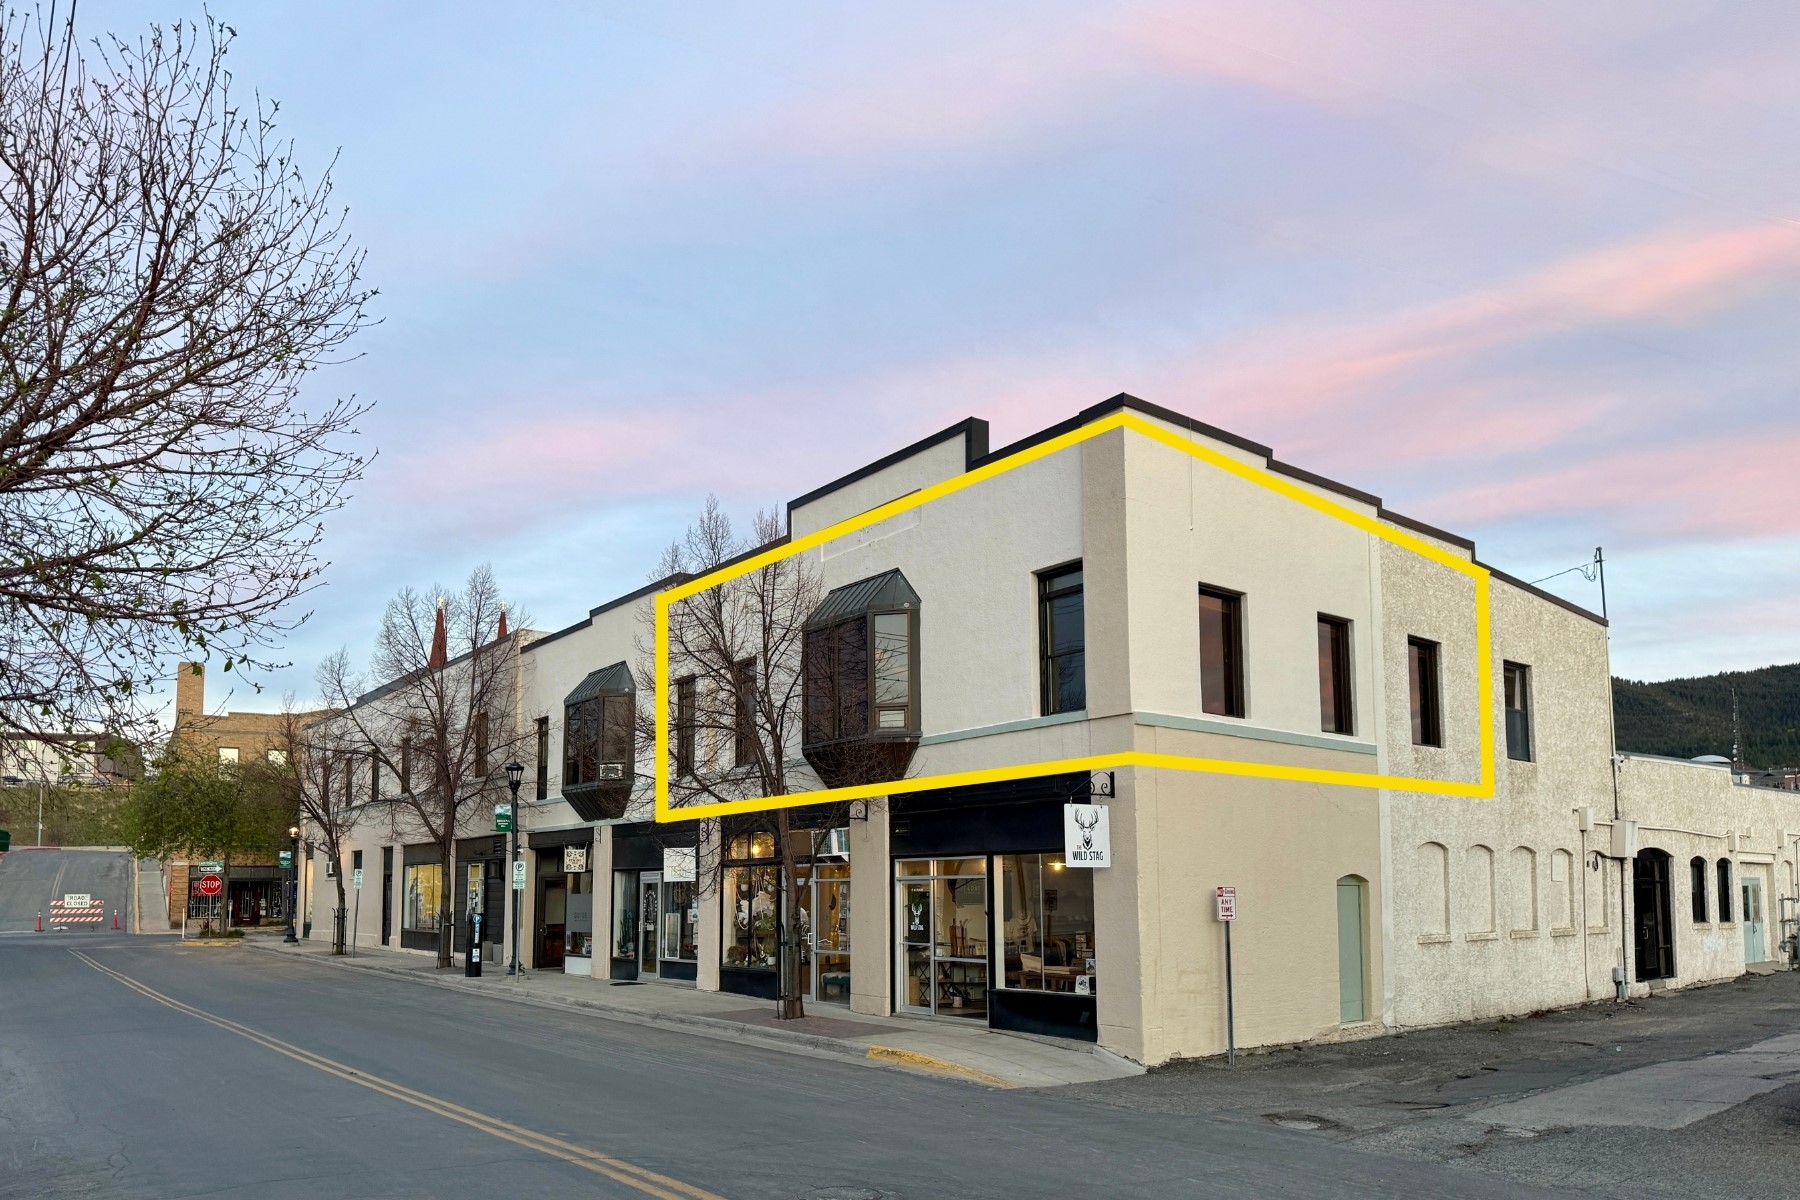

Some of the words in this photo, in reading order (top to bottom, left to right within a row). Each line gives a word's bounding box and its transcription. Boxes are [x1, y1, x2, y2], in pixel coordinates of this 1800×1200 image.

[1072, 851, 1088, 860] WILD
[1089, 851, 1104, 860] STAG
[202, 880, 220, 888] STOP
